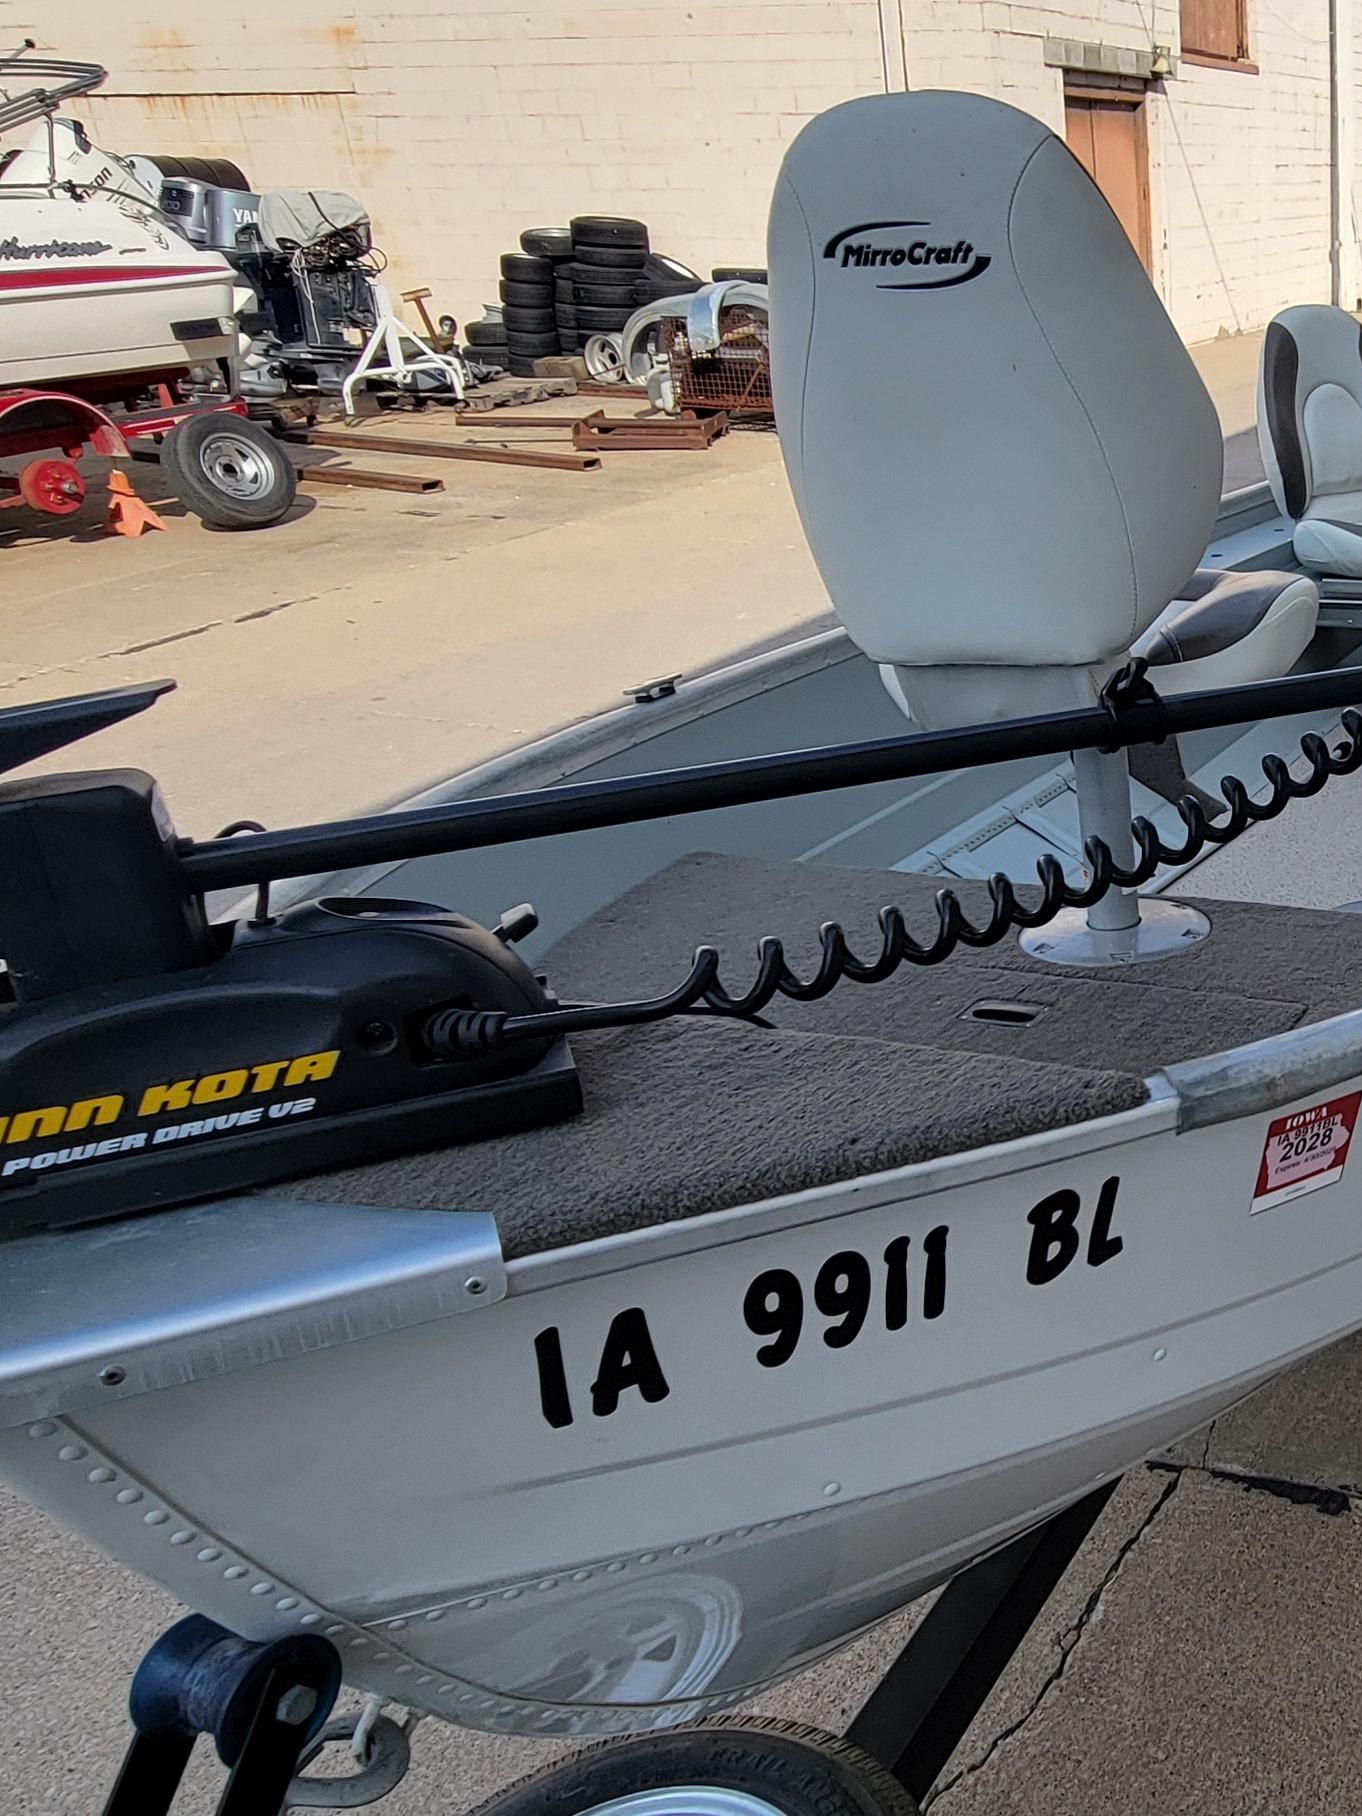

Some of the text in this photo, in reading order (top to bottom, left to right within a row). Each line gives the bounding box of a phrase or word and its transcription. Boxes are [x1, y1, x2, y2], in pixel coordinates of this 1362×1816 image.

[841, 240, 974, 268] MirroCraft
[138, 1050, 341, 1116] KOTA
[1277, 1116, 1338, 1146] IA 9911BL
[1285, 1106, 1328, 1130] IOWA
[2, 1097, 316, 1176] POWER DRIVE V2
[1279, 1128, 1334, 1163] 2028
[534, 1176, 1124, 1429] IA 9911 BL
